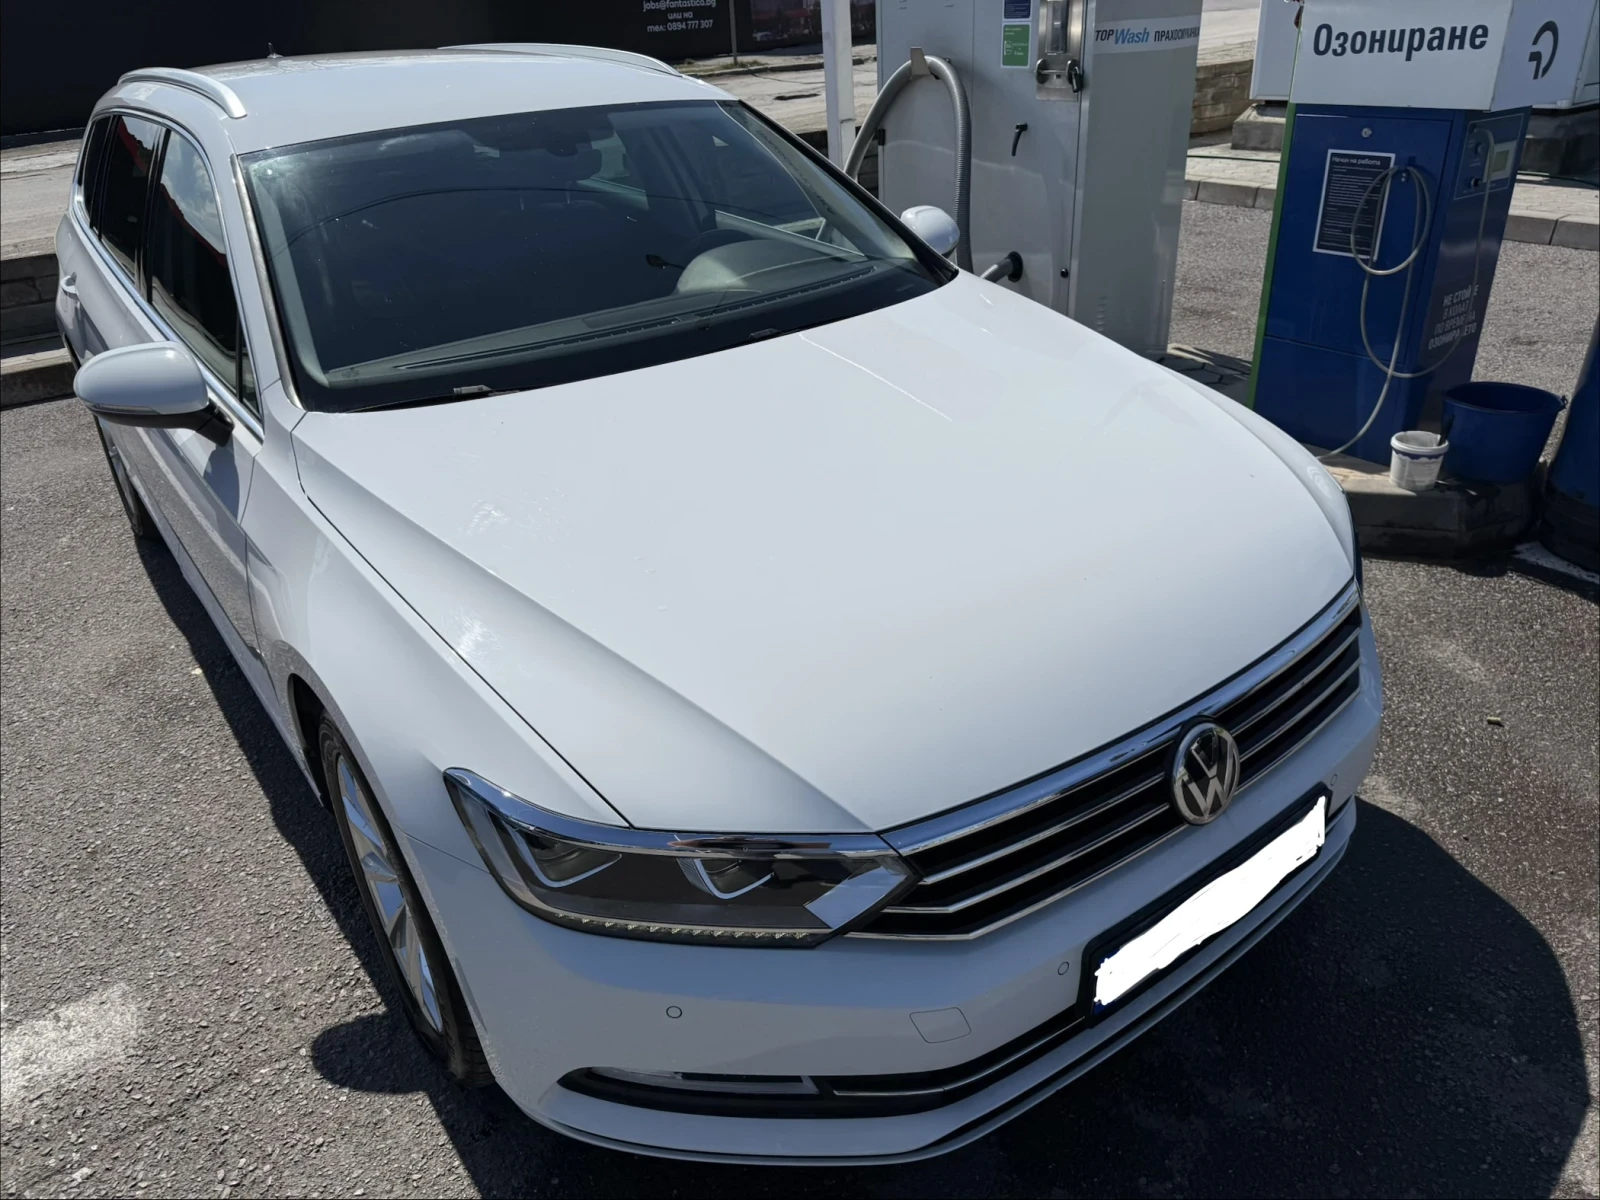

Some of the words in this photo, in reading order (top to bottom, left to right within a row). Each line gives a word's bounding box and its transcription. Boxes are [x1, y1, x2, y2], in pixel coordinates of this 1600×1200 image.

[667, 21, 686, 31] 0894
[687, 20, 699, 29] 777
[700, 19, 713, 28] 307
[1313, 23, 1489, 62] Озониране
[1443, 293, 1453, 307] НЕ
[1453, 284, 1479, 304] СТОЙЕ
